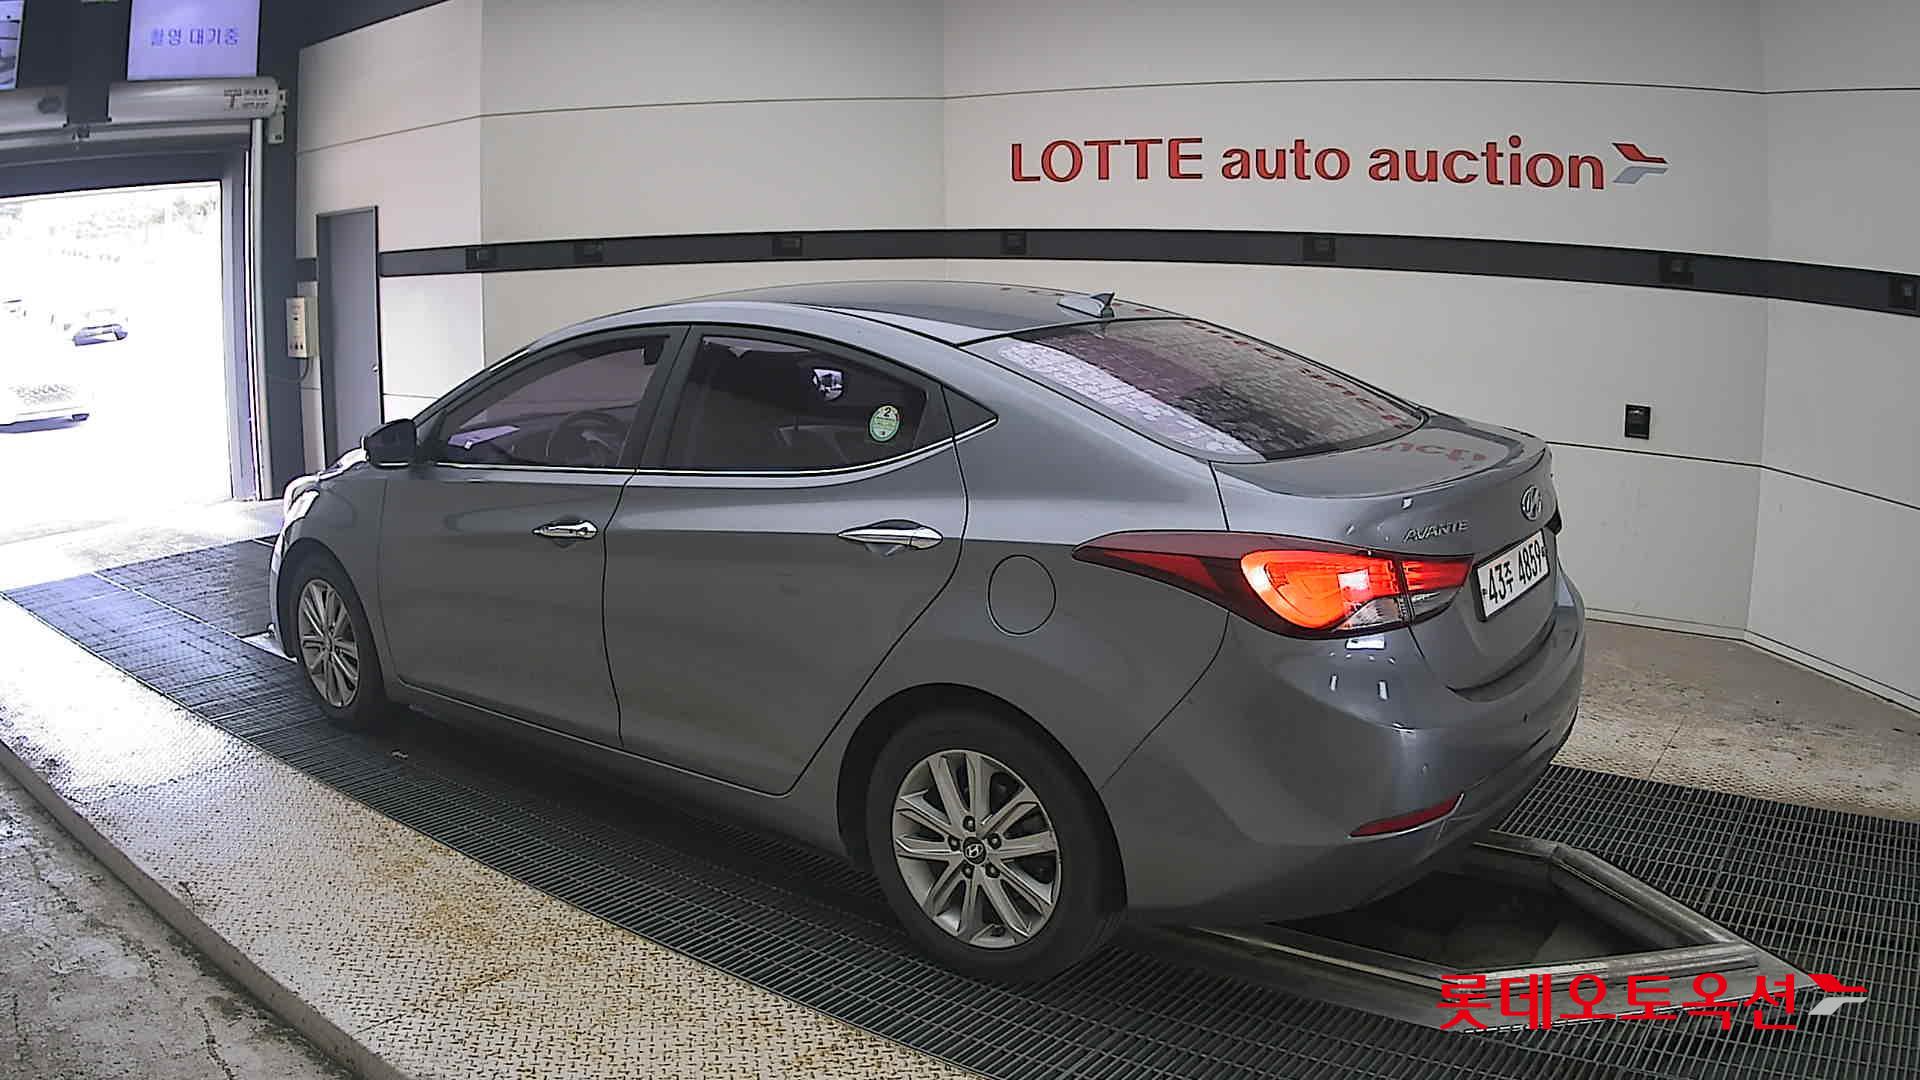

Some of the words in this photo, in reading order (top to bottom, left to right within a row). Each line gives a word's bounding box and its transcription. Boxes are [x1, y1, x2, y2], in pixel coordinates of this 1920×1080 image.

[189, 28, 239, 46] 대기중
[1011, 138, 1204, 182] LOTTE
[1220, 139, 1351, 181] auto
[1368, 134, 1605, 190] auction
[883, 406, 891, 417] 2
[1403, 521, 1470, 543] AVANTE
[1489, 561, 1513, 604] 43주
[1518, 540, 1542, 584] 4859
